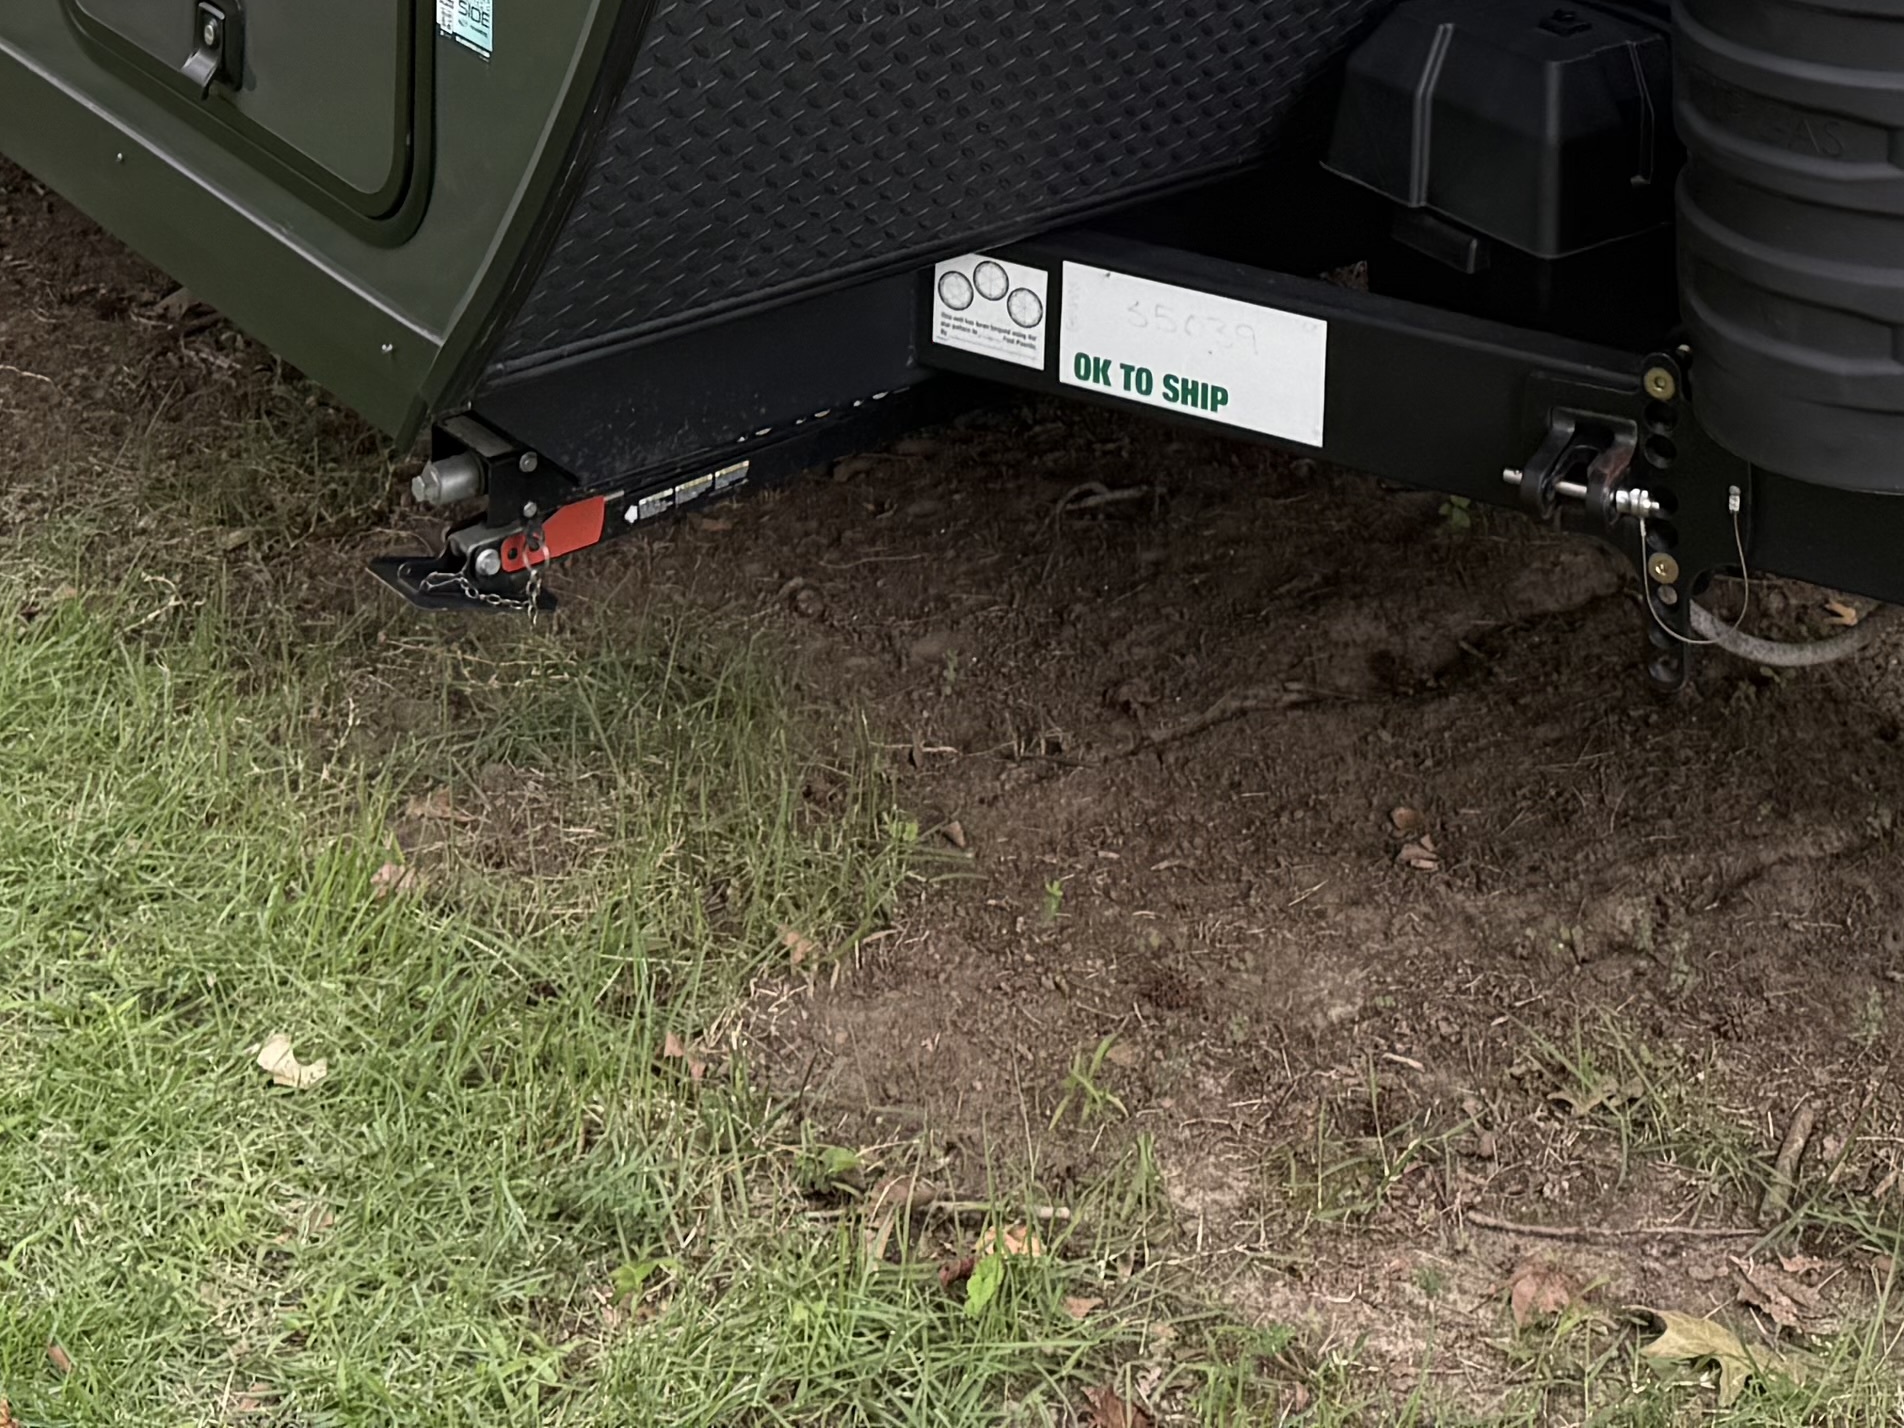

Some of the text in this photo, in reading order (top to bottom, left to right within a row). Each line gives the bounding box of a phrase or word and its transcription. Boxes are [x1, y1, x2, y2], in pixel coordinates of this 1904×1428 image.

[458, 0, 491, 29] SIDE
[1074, 351, 1230, 413] OK TO SHIP
